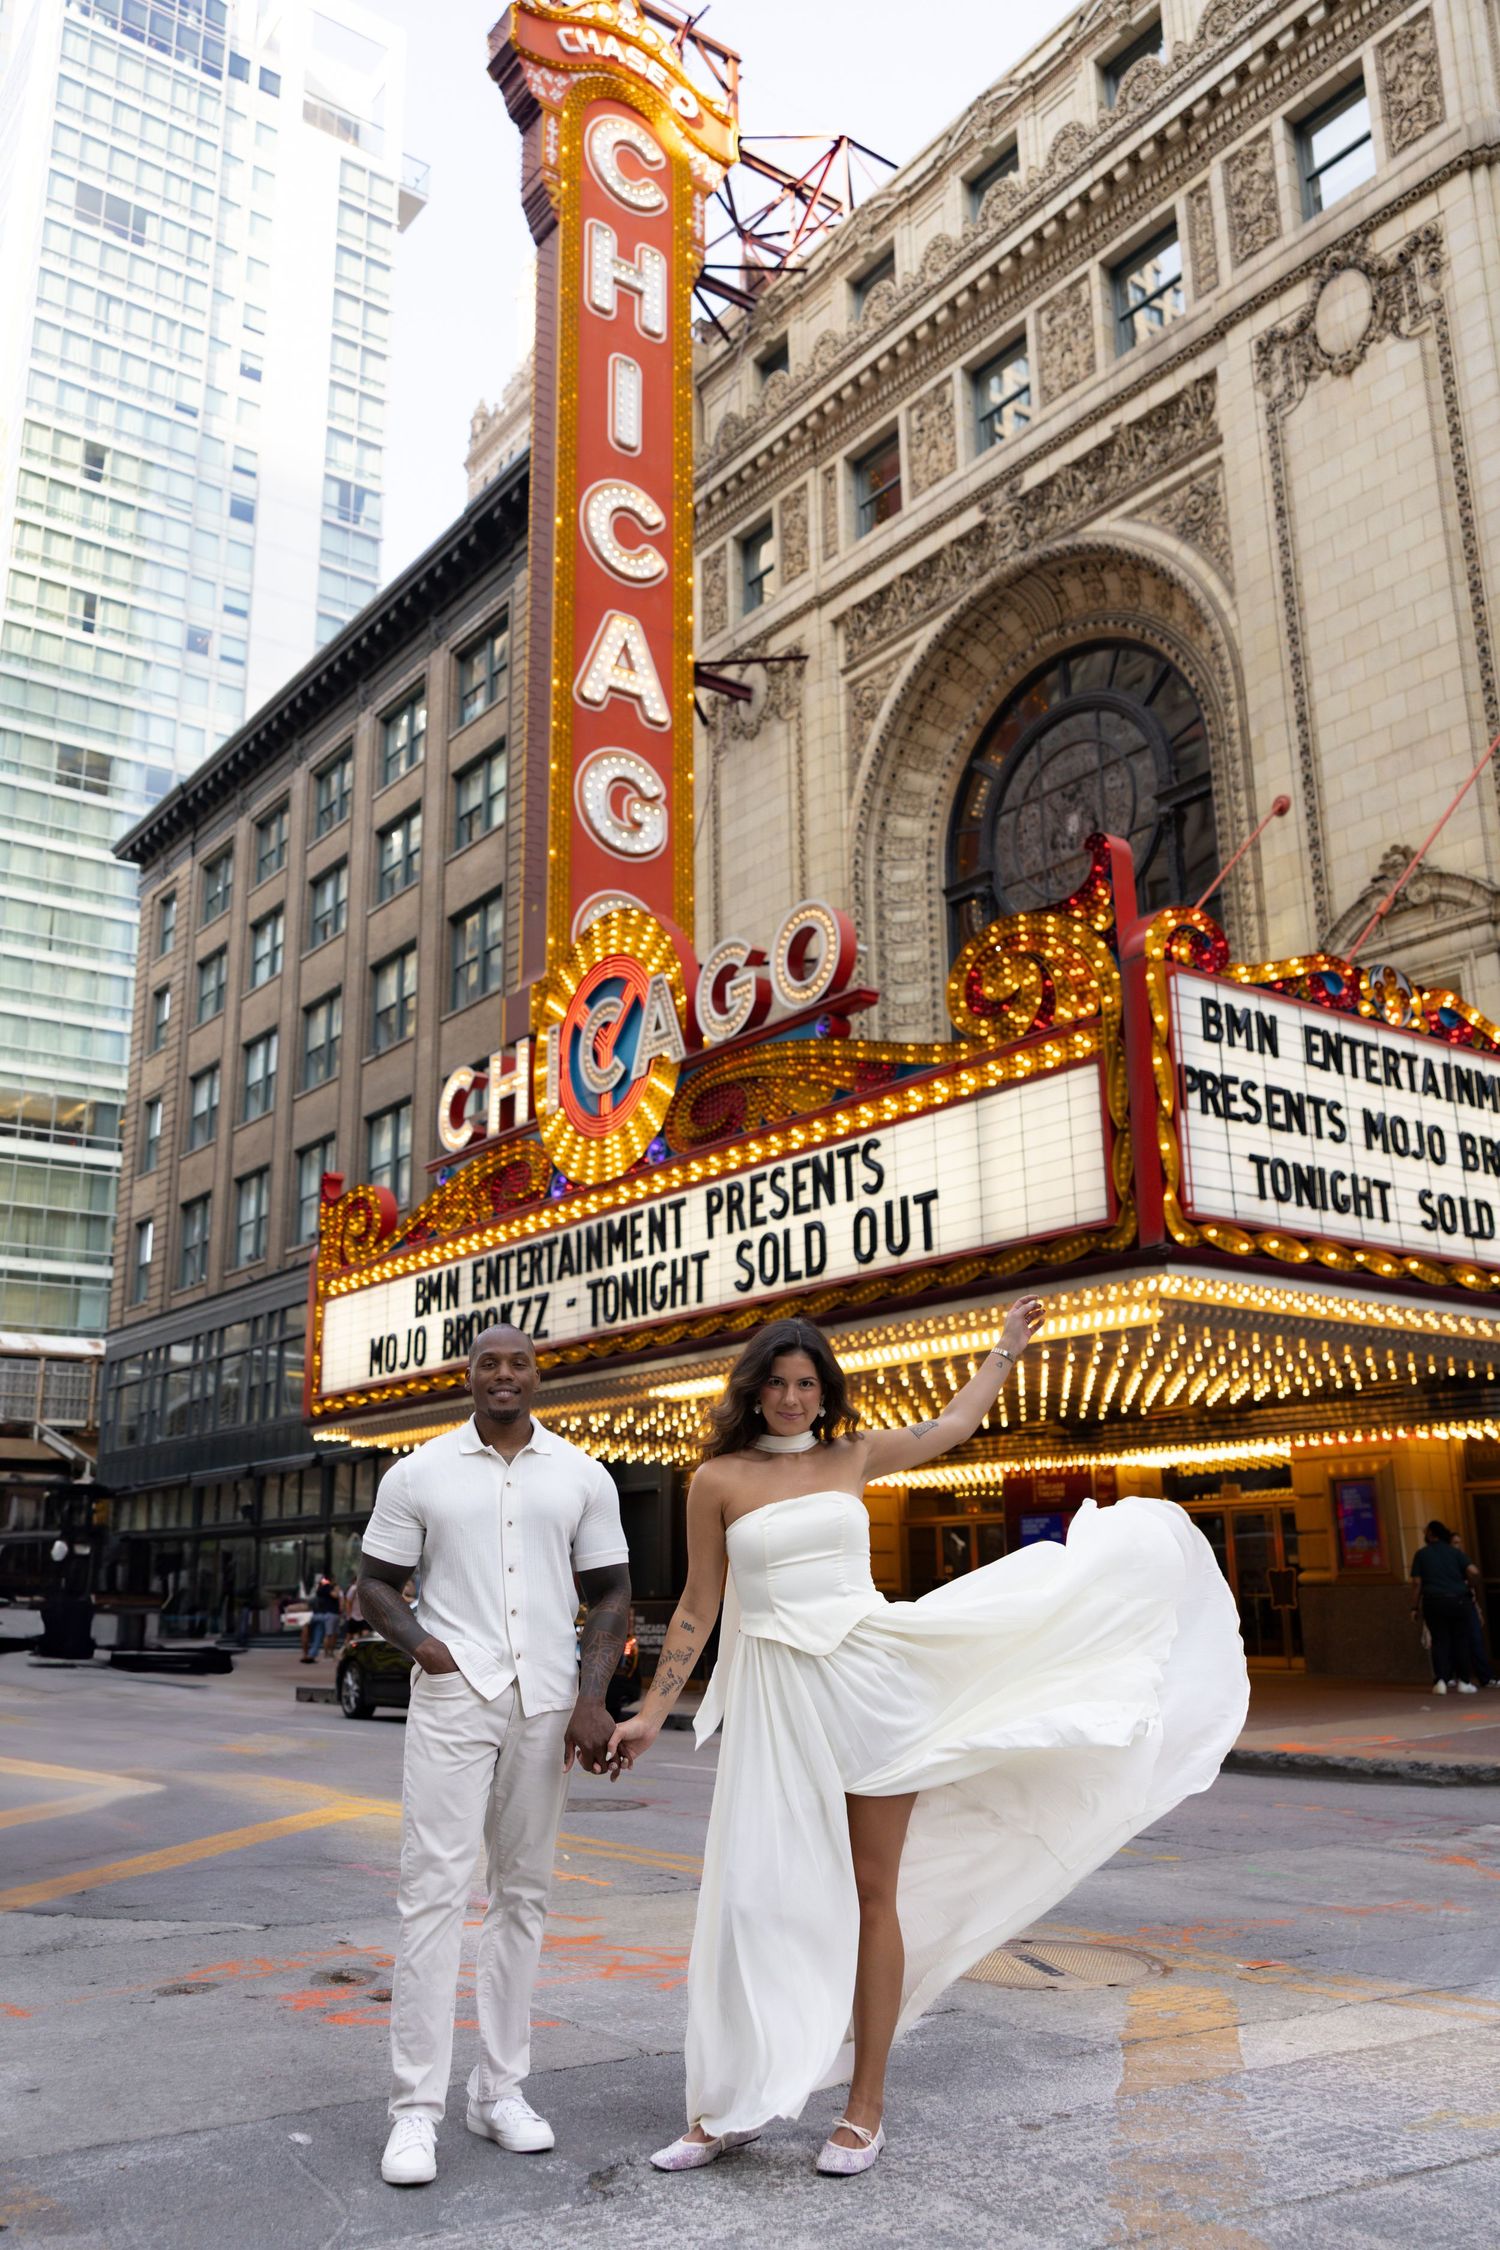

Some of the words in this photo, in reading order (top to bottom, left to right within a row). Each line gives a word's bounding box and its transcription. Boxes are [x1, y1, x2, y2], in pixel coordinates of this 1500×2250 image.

[556, 27, 670, 90] CHASE
[572, 113, 671, 942] CHICAG
[438, 900, 842, 1152] CHICAGO
[1200, 996, 1279, 1059] BMN
[1304, 1024, 1500, 1114] ENTERTAINM
[1177, 1064, 1348, 1143] PRESENTS
[1363, 1107, 1447, 1166] MOJO
[415, 1266, 461, 1318] BMN
[472, 1197, 687, 1302] ENTERTAINMENT
[706, 1138, 885, 1239] PRESENTS
[1248, 1153, 1391, 1223] TONIGHT
[1418, 1189, 1496, 1240] SOLD
[369, 1325, 427, 1377] MOJO
[587, 1250, 710, 1328] TONIGHT
[734, 1220, 827, 1292] SOLD
[853, 1189, 939, 1265] OUT
[635, 1624, 667, 1634] CHICAGO
